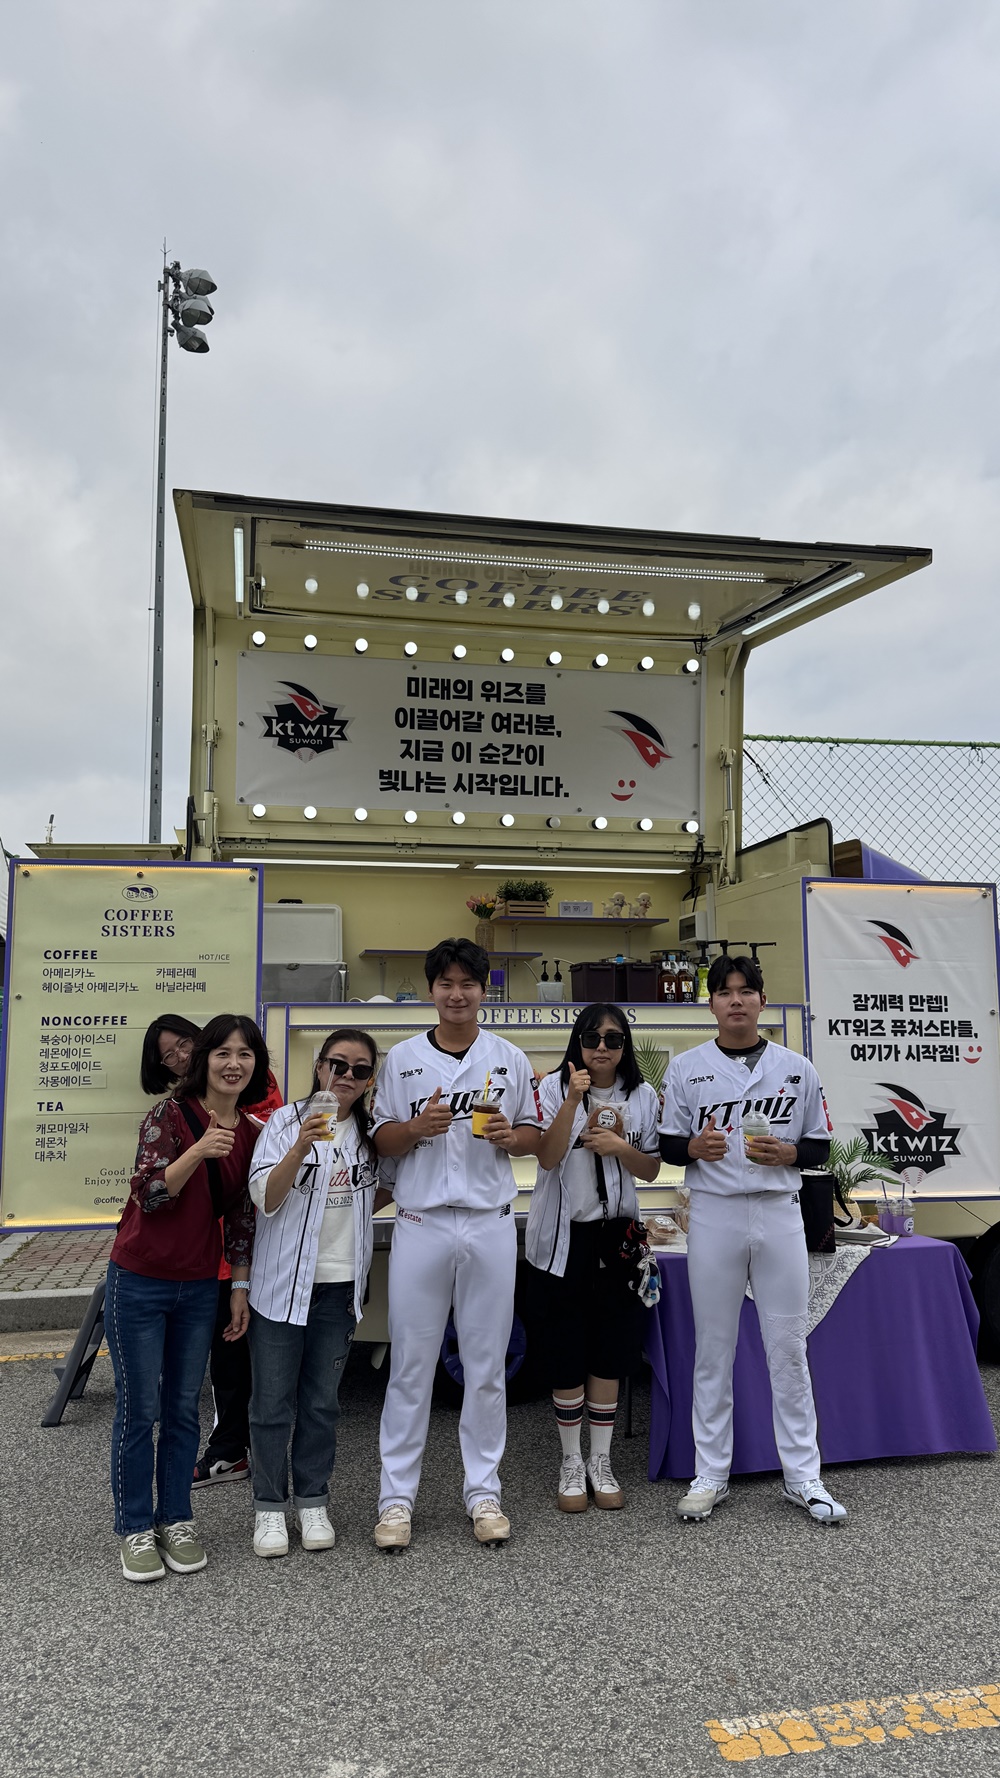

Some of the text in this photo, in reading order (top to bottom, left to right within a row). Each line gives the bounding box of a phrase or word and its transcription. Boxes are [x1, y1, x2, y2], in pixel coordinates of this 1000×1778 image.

[388, 574, 653, 604] COFFEE
[370, 588, 638, 617] SISTERS
[406, 676, 547, 705] 미래의 위즈를
[271, 717, 296, 737] kt
[394, 707, 563, 739] 이끌어갈 여러분,
[288, 737, 324, 746] suwon
[399, 739, 545, 767] 지금 이 순간이
[378, 769, 571, 798] 빛나는 시작입니다.
[103, 909, 174, 922] COFFEE
[100, 925, 176, 938] SISTERS
[43, 949, 231, 961] COFFEE HOT/ICE
[42, 967, 198, 979] 아메리카노 카페라떼
[41, 981, 207, 994] 헤이즐넛 아메리카노 바닐라라떼
[852, 994, 950, 1013] 잠재력 만렙!
[40, 1016, 128, 1027] NONCOFFEE
[476, 1008, 637, 1024] OFFEE SISS
[827, 1019, 979, 1039] KT위즈 퓨처스타들,
[39, 1033, 117, 1046] 복숭아 아이스티
[39, 1047, 93, 1060] 레몬에이드
[850, 1043, 961, 1063] 여기가 시작점!
[39, 1060, 103, 1073] 청포도에이드
[38, 1075, 93, 1088] 자몽에이드
[36, 1101, 64, 1112] TEA
[35, 1122, 90, 1135] 캐모마일차
[35, 1136, 68, 1149] 레몬차
[871, 1131, 900, 1153] kt
[34, 1150, 68, 1163] 대추차
[893, 1154, 933, 1164] suwon
[99, 1167, 126, 1176] Good
[84, 1177, 112, 1187] Enjoy
[93, 1196, 127, 1206] @coffee_
